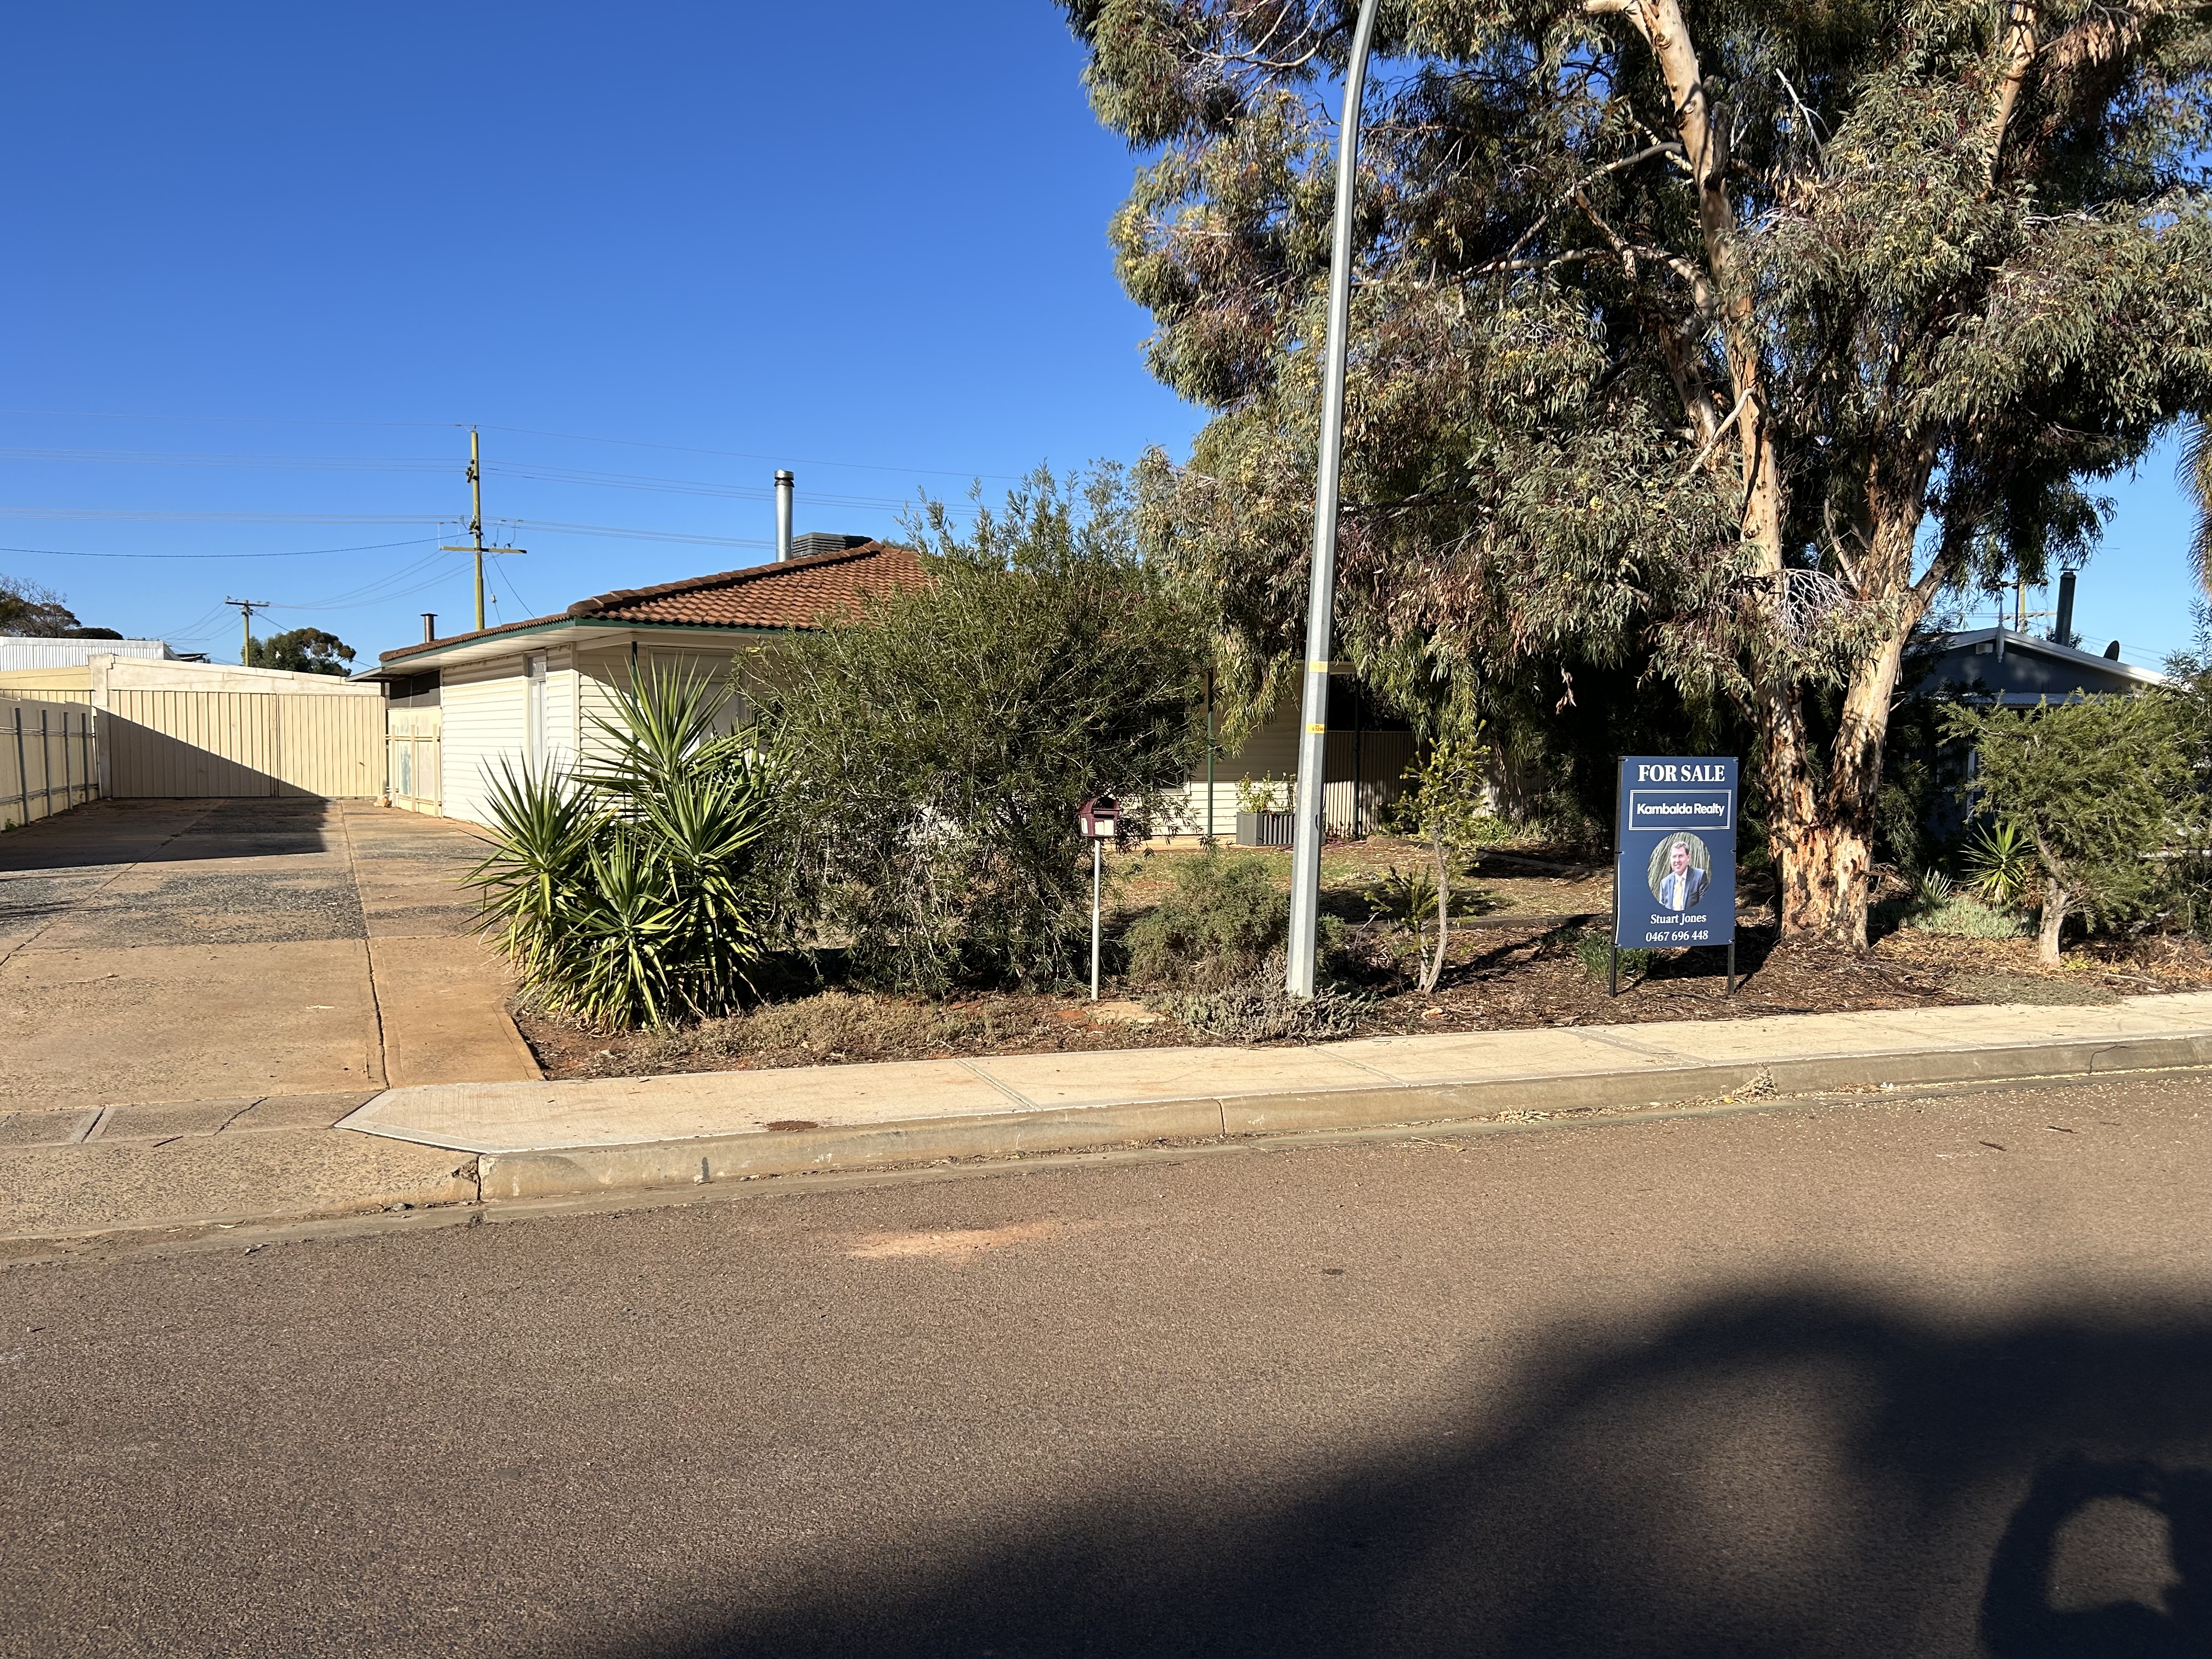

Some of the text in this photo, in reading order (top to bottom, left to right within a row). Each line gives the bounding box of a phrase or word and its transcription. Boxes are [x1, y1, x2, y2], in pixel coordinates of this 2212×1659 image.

[1638, 764, 1725, 782] FOR SALE
[1637, 803, 1725, 817] Kambalda Realty
[1650, 913, 1707, 926] Stuart Jones
[1645, 930, 1708, 942] 0467 696 448
